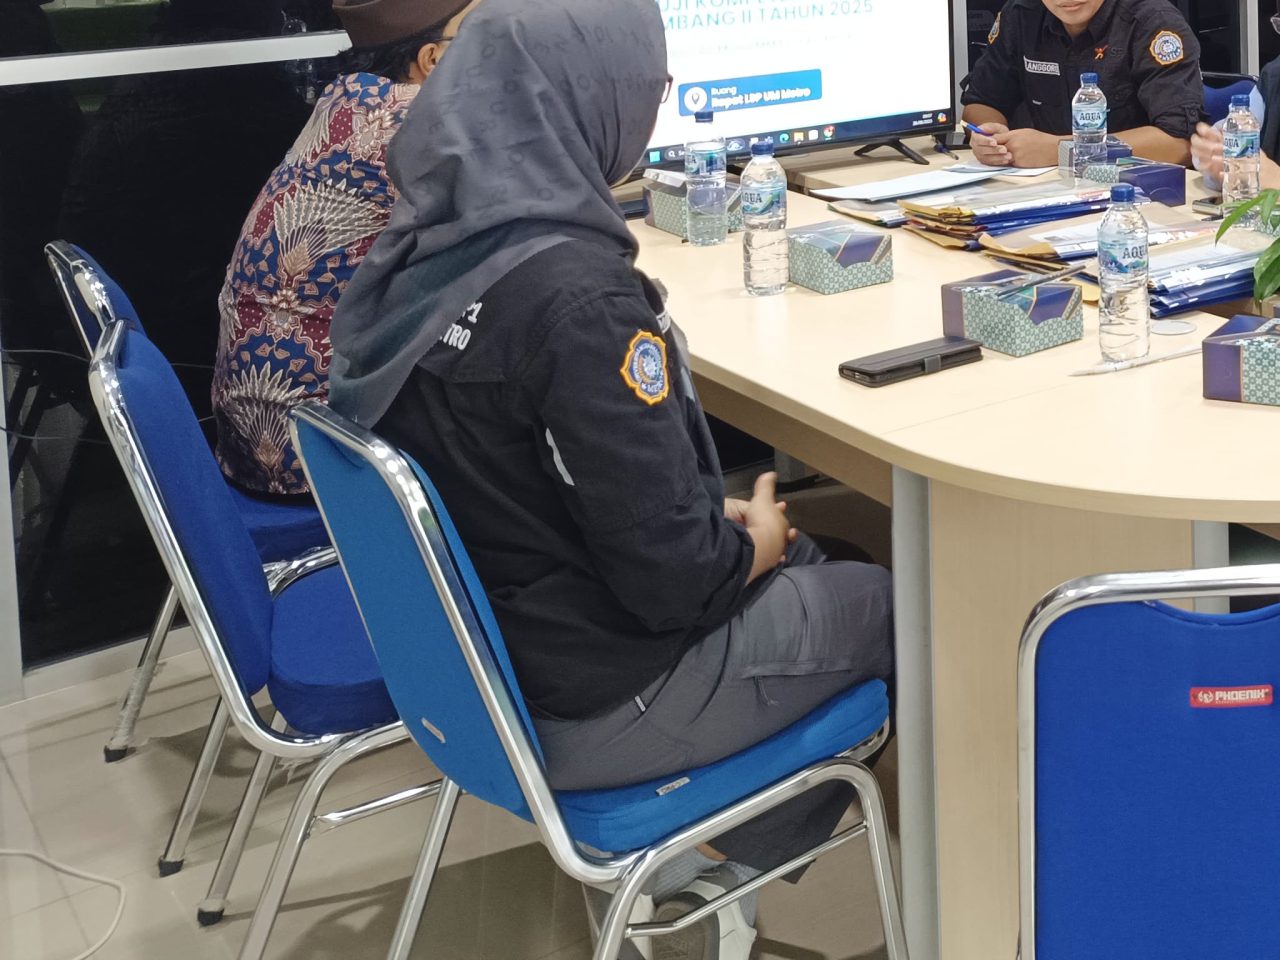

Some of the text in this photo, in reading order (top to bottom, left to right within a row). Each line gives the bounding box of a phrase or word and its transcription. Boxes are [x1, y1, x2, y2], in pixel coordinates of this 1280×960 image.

[754, 3, 825, 23] TAHUN
[1079, 109, 1102, 121] AQUA
[1223, 136, 1239, 148] QUA
[742, 193, 762, 204] QUA
[1215, 689, 1265, 701] PHOENIX
